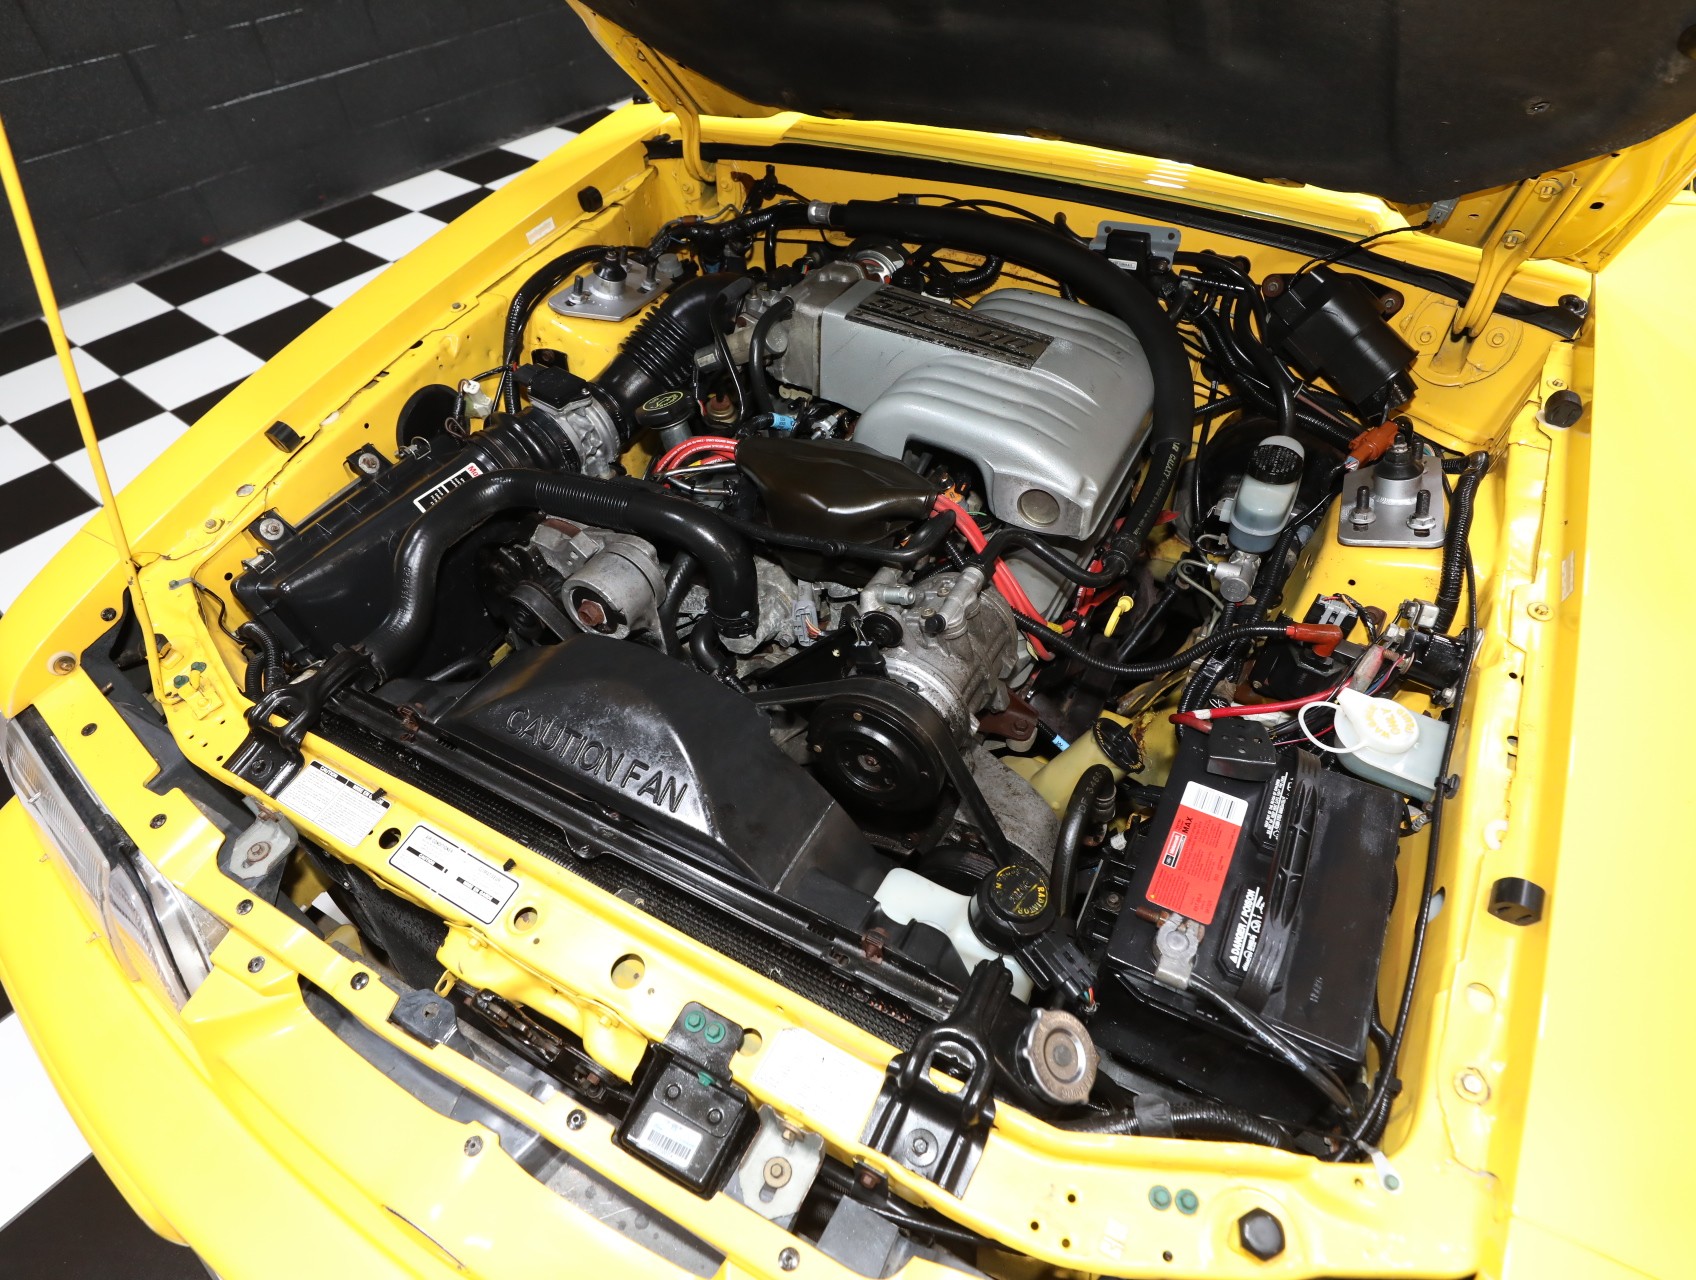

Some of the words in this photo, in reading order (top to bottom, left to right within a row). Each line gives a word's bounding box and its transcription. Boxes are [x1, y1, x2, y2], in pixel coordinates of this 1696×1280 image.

[1163, 453, 1177, 480] GALAXY
[505, 707, 624, 783] CAUTION
[620, 758, 689, 813] FAN
[1182, 816, 1194, 834] MAX
[1231, 923, 1246, 955] DANGER
[1241, 888, 1255, 916] POISON
